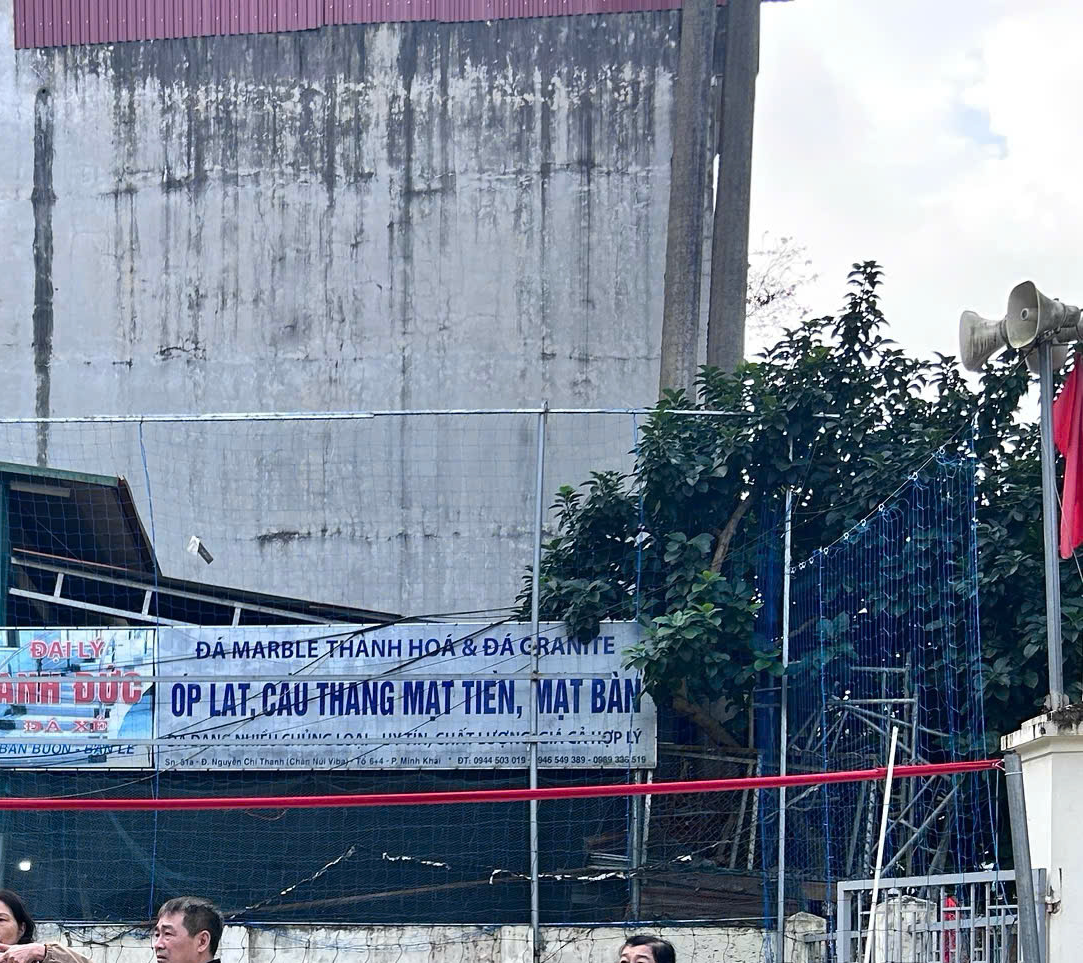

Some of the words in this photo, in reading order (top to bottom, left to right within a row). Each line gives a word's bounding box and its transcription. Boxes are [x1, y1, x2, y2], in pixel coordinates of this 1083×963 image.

[30, 641, 71, 663] ĐẠI
[195, 636, 226, 659] ĐÁ
[232, 640, 319, 659] MARBLE
[409, 633, 456, 657] HOÁ
[462, 638, 478, 657] &
[482, 633, 515, 656] ĐÁ
[73, 665, 143, 704] ĐỨC
[317, 680, 395, 716] THANG
[591, 671, 642, 714] BÀN
[626, 727, 643, 744] LÝ
[400, 756, 420, 765] Minh
[423, 756, 441, 765] Khai
[473, 756, 493, 764] 0944
[494, 756, 510, 764] 503
[535, 756, 553, 764] 946
[554, 756, 569, 764] 549
